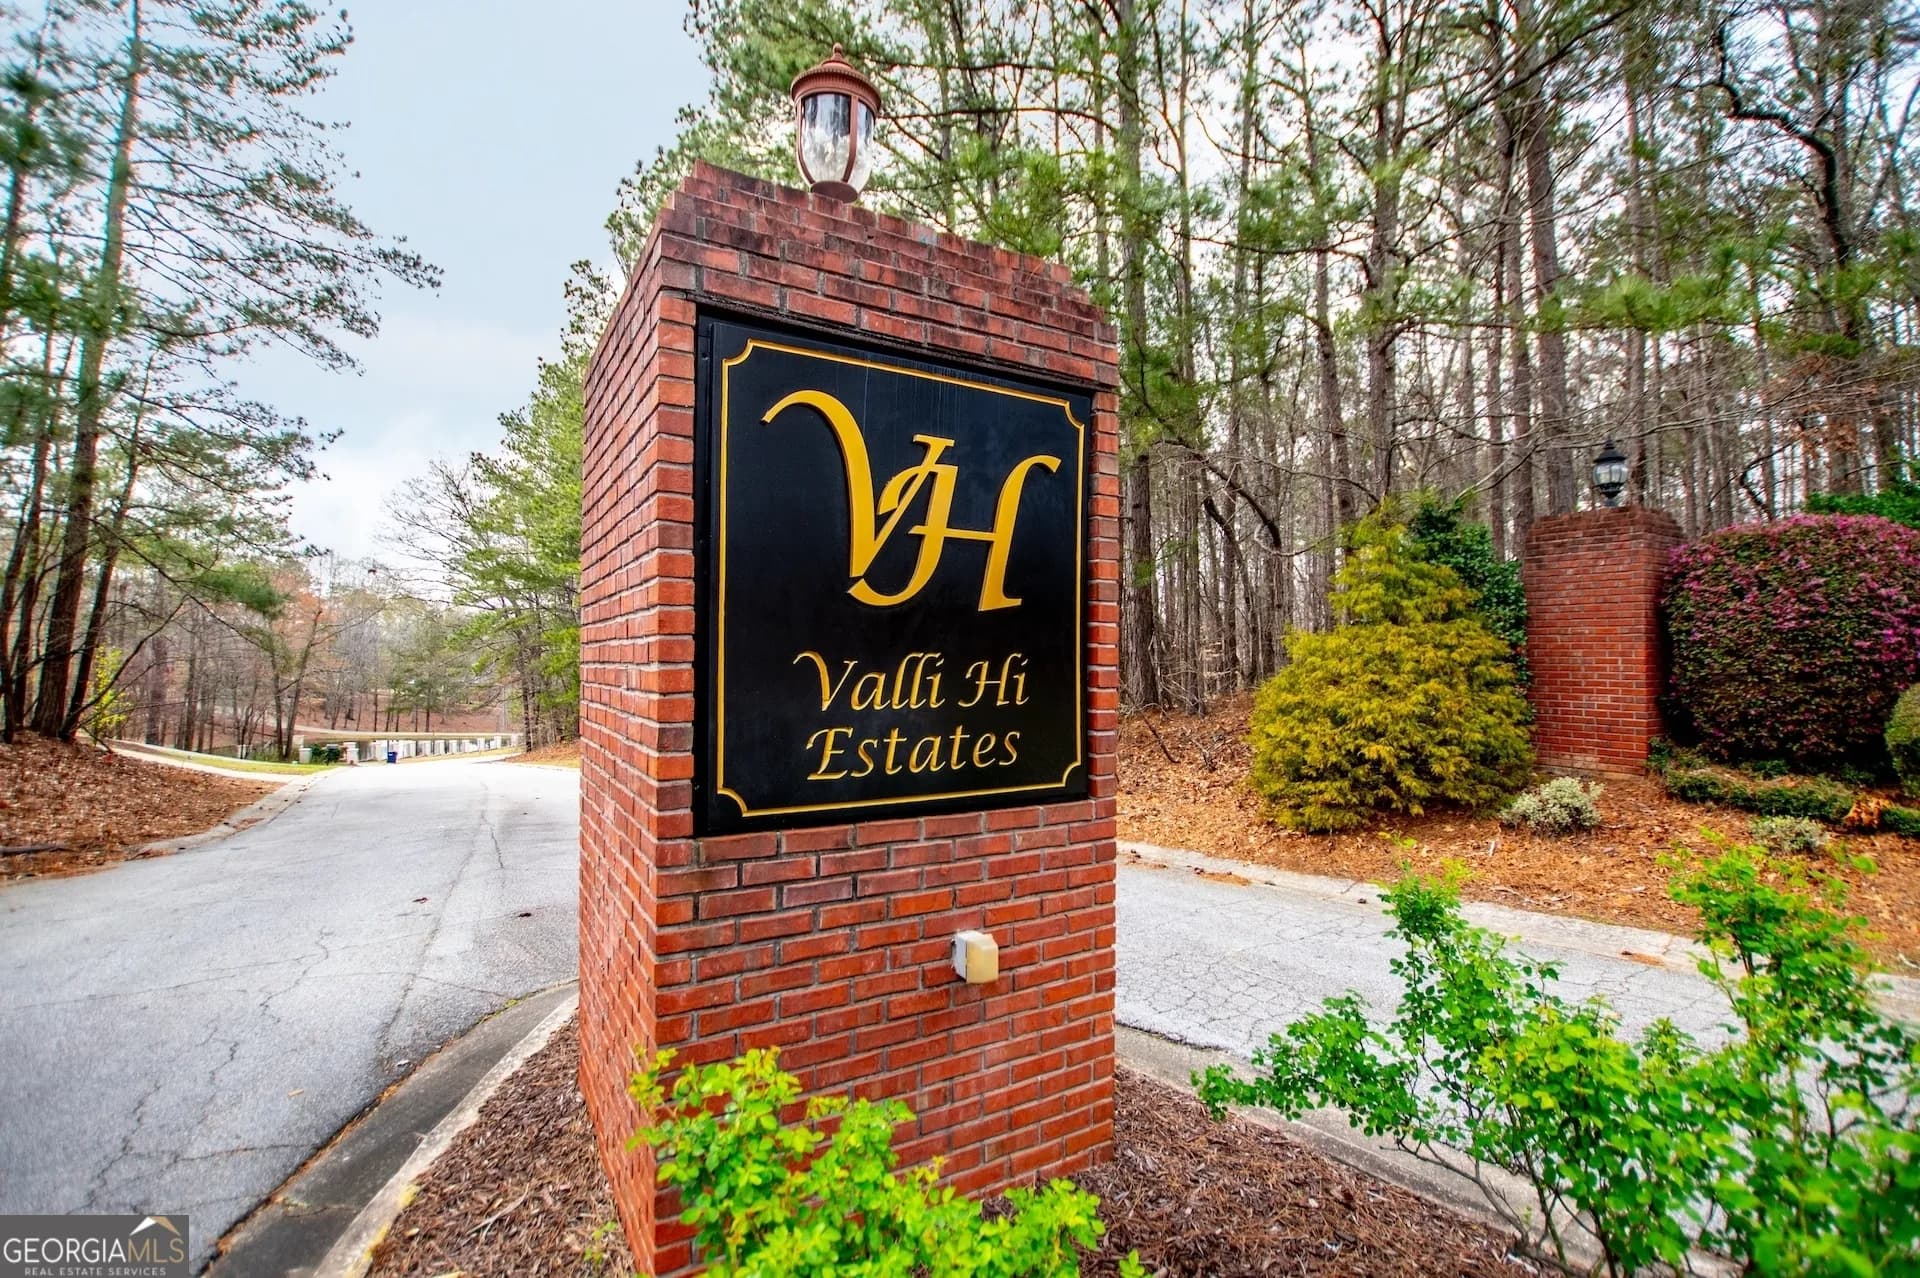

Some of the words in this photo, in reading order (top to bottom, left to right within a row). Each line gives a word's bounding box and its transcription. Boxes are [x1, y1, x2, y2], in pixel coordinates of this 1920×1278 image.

[793, 651, 946, 712] Valli
[957, 652, 1030, 708] Hi
[805, 726, 1021, 781] Estates
